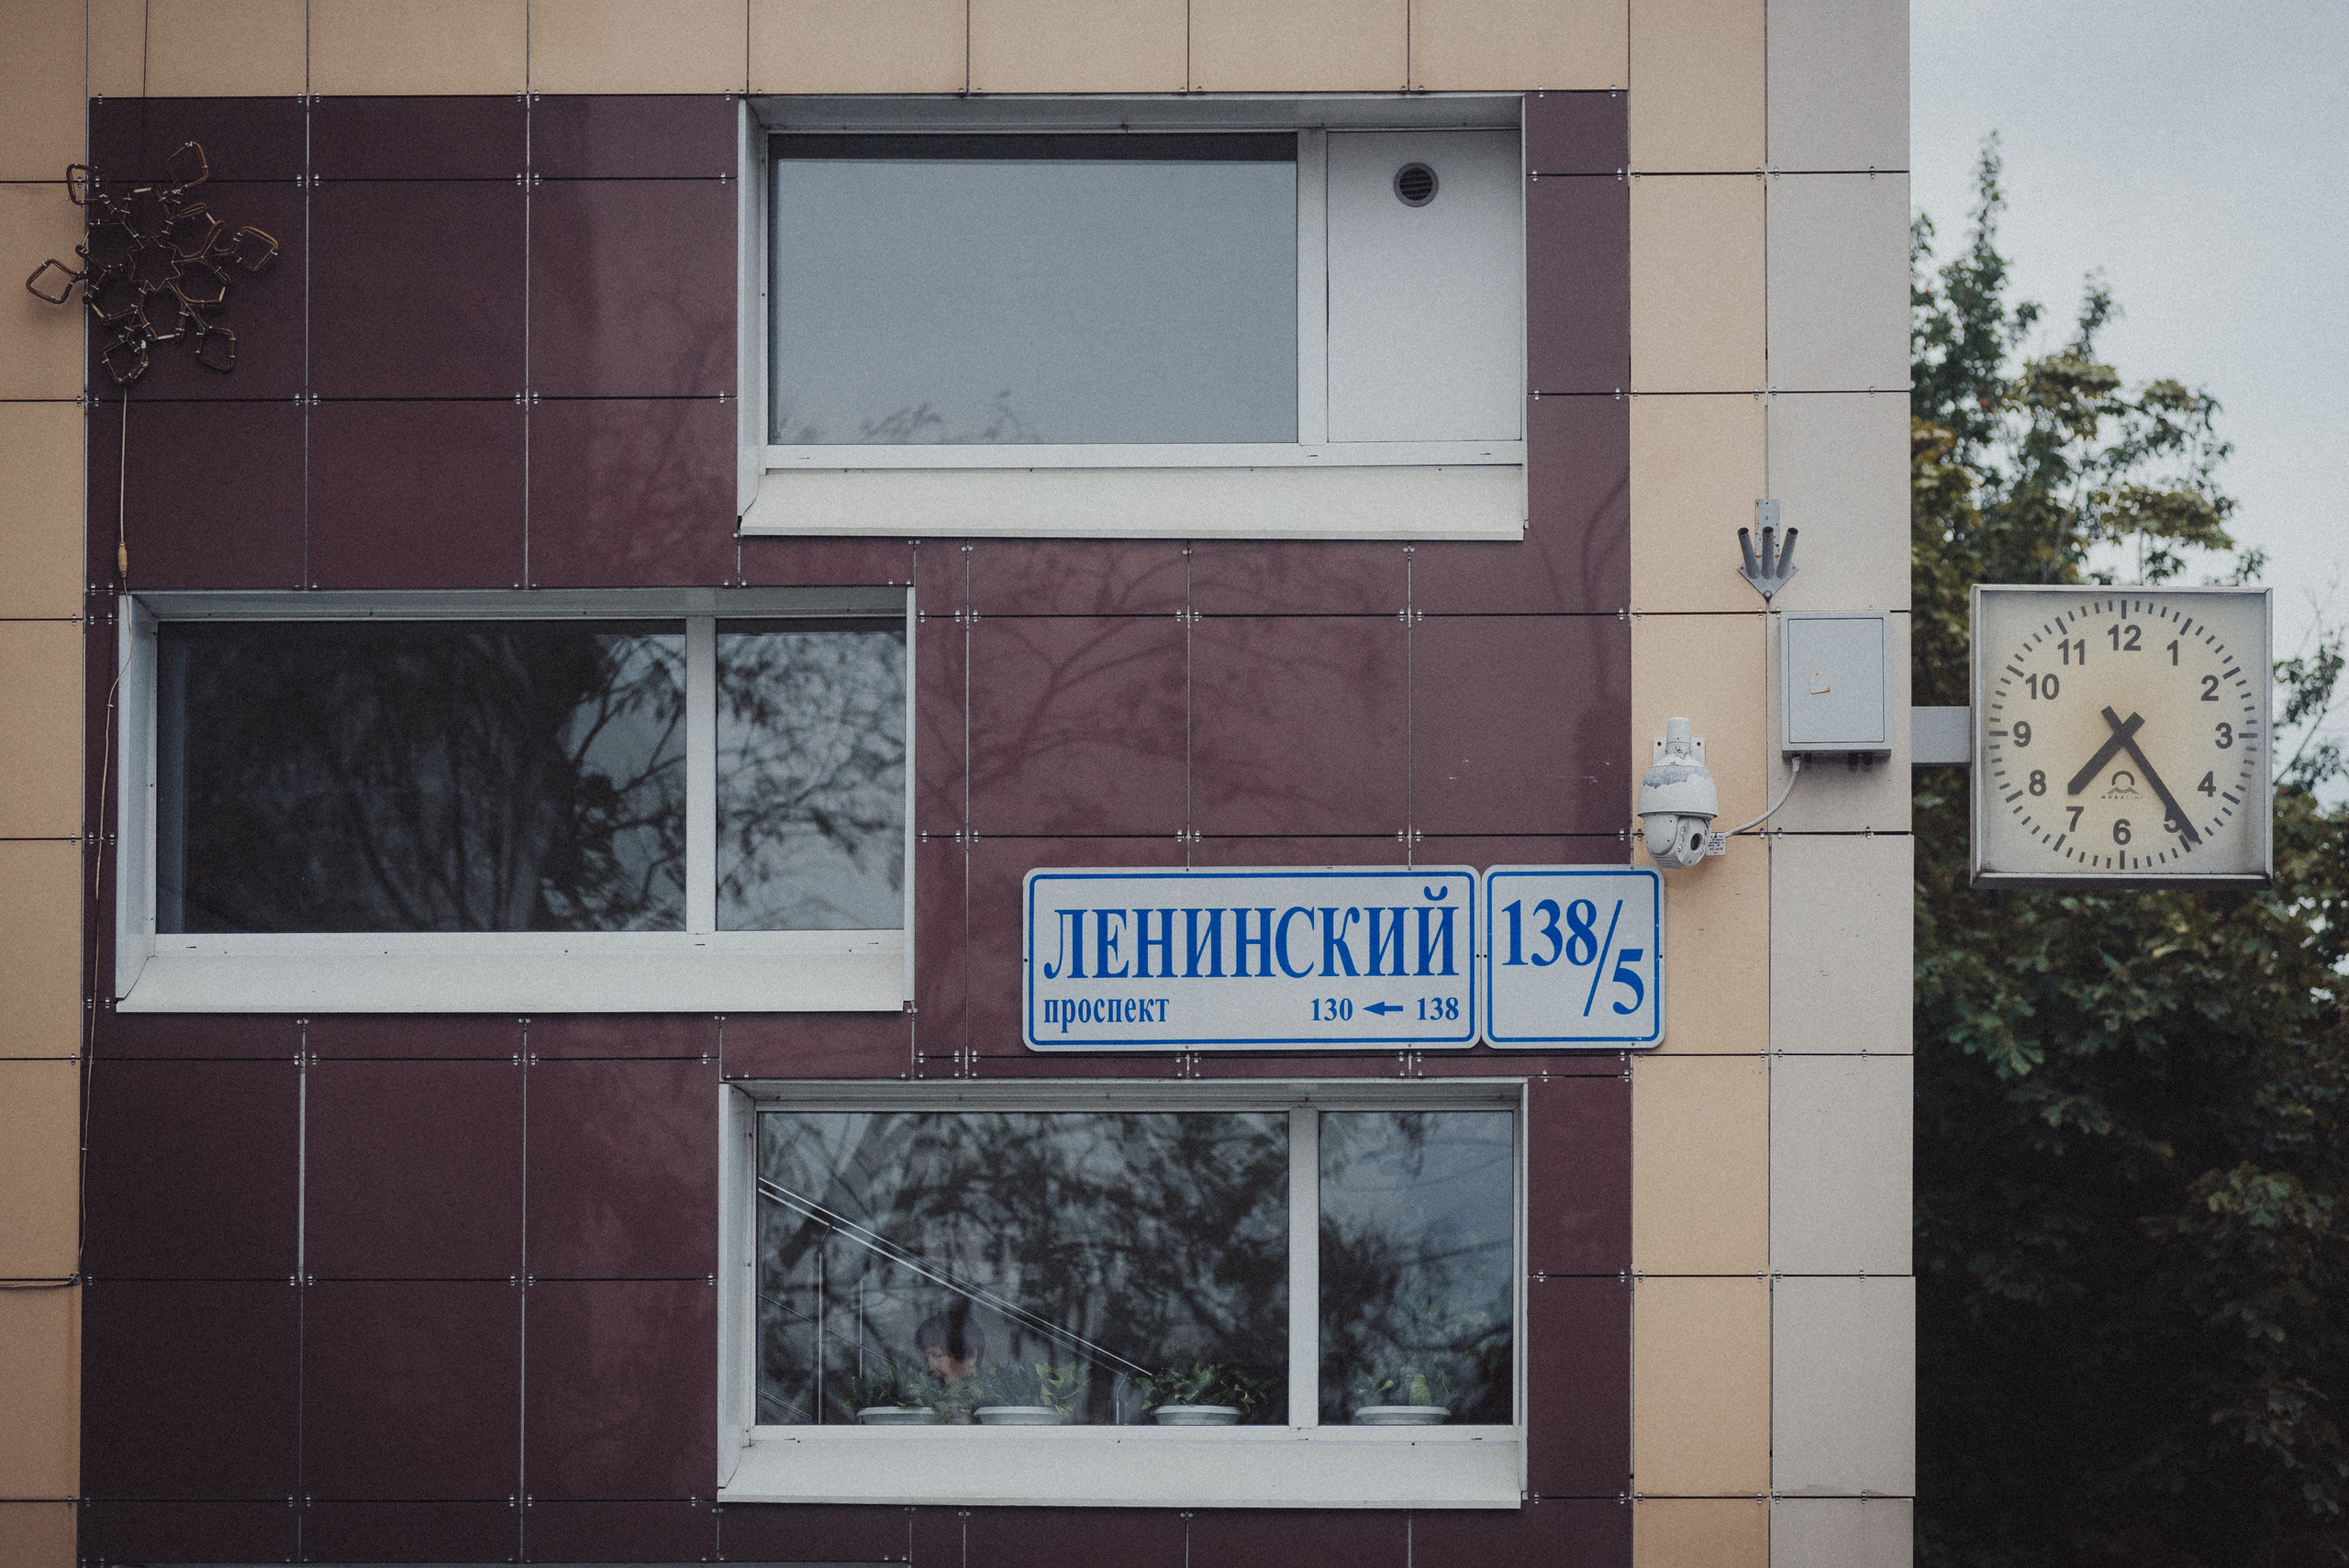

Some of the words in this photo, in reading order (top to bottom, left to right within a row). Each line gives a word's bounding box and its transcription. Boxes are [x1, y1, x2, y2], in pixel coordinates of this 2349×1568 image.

[2107, 625, 2142, 651] 12
[2057, 639, 2085, 665] 11
[2166, 639, 2178, 665] 1
[2025, 673, 2060, 700] 10
[2200, 674, 2219, 701] 2
[2013, 721, 2032, 747] 9
[2215, 722, 2232, 749] 3
[2029, 770, 2047, 796] 8
[2198, 772, 2217, 797] 4
[2065, 806, 2084, 831] 7
[2113, 819, 2131, 845] 6
[1043, 885, 1460, 979] ЛЕНИНСКИЙ
[1500, 898, 1645, 1018] 138/5
[1043, 997, 1170, 1034] проспект
[1310, 997, 1353, 1022] 130
[1417, 996, 1460, 1021] 138
